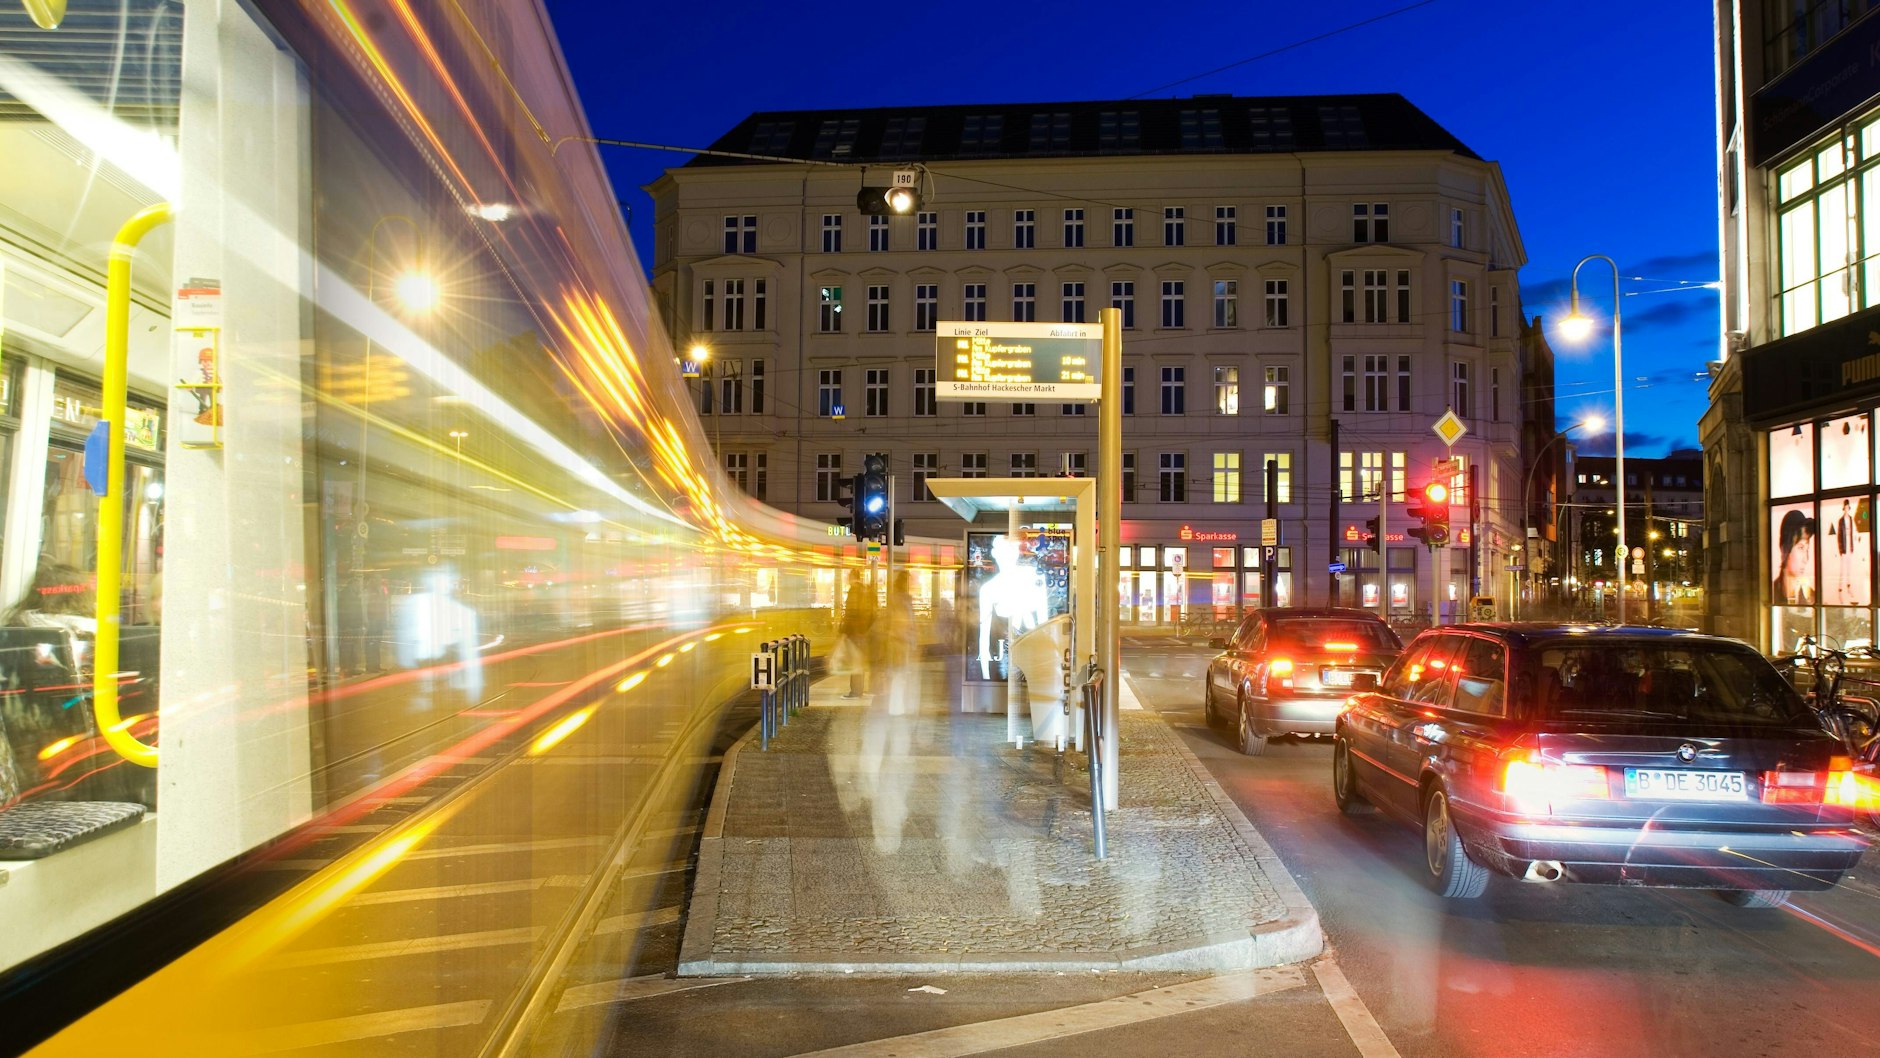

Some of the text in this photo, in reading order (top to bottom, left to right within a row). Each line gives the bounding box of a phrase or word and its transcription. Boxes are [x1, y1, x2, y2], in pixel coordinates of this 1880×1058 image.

[897, 174, 911, 184] 190
[954, 328, 972, 336] Linie
[975, 328, 989, 336] Ziel
[1050, 329, 1078, 338] Abfahrt
[685, 361, 697, 373] W
[953, 383, 1056, 393] S-Bahnhof Hackescher Markt
[833, 406, 844, 415] W
[1195, 532, 1237, 541] Sparkasse
[1265, 546, 1274, 561] P
[754, 657, 772, 685] H
[1638, 772, 1742, 793] B DE 3045
